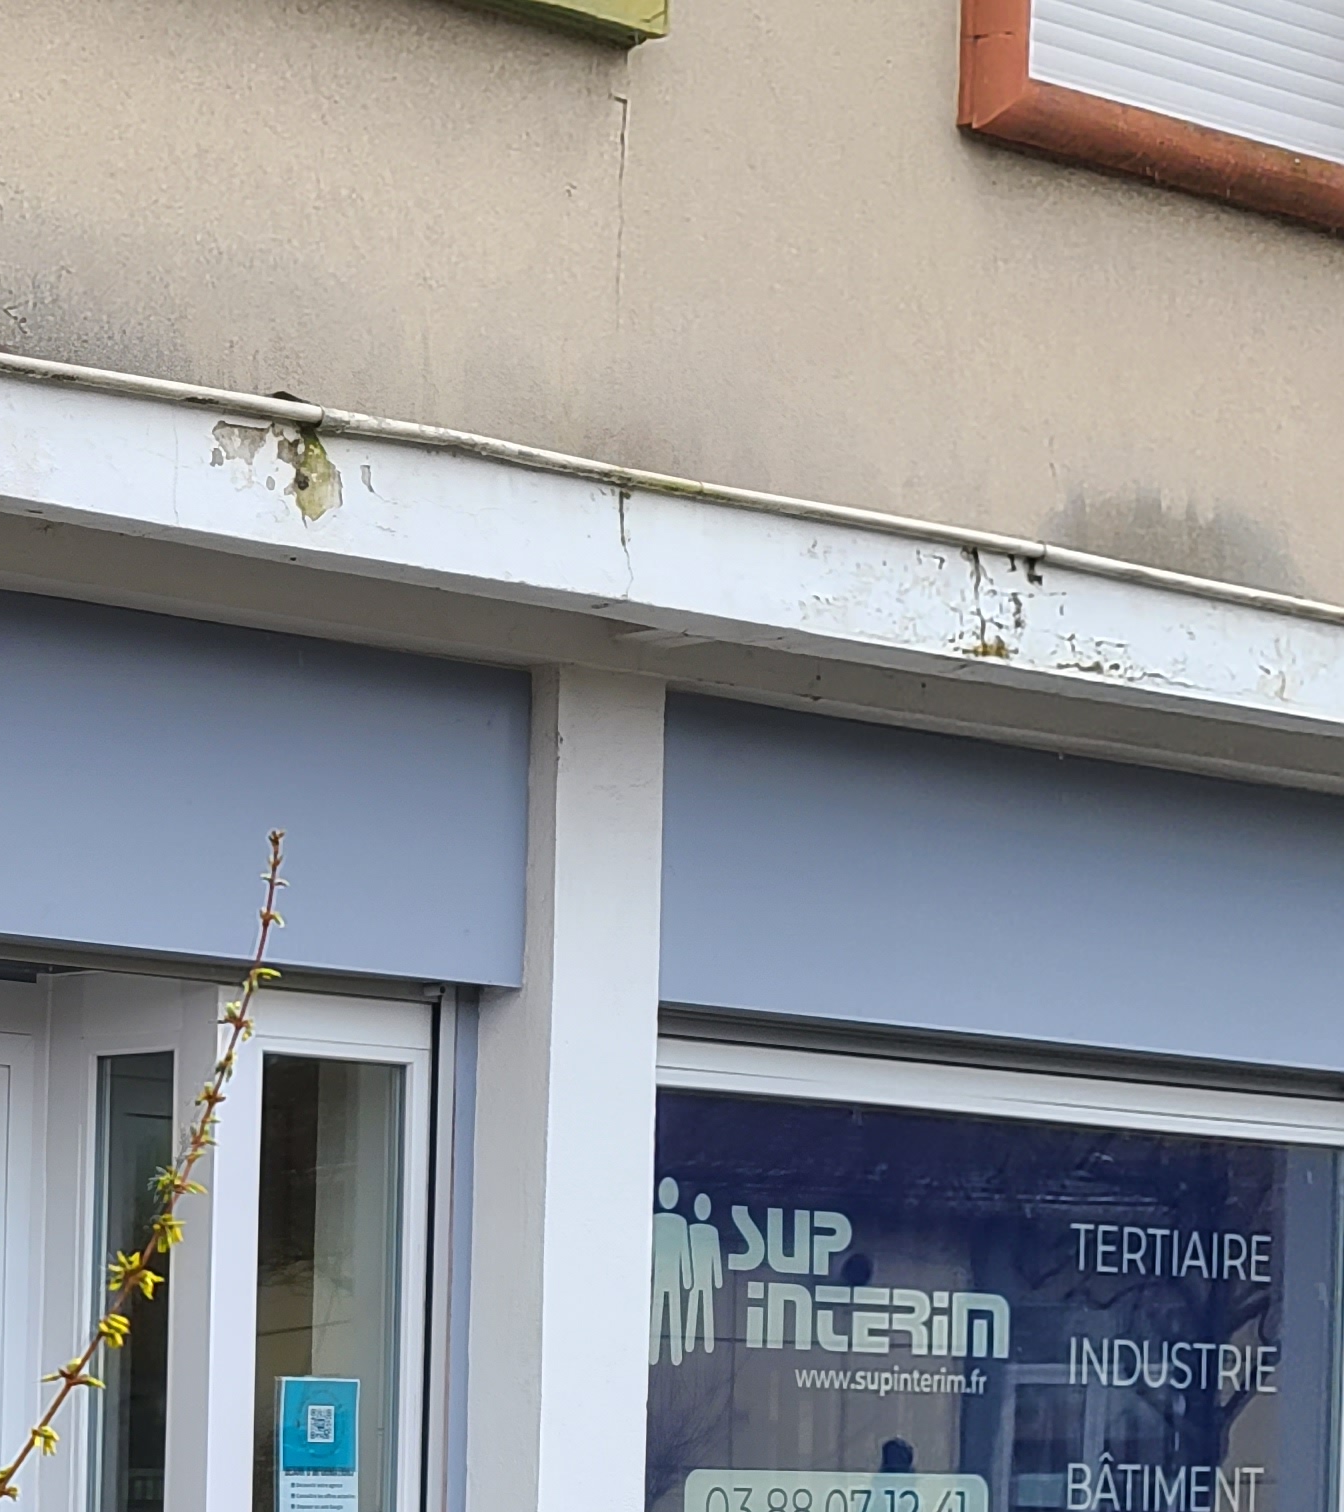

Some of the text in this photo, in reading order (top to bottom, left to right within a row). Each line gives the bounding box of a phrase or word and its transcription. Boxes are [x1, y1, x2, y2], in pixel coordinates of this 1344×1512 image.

[727, 1205, 853, 1276] SUP
[1069, 1222, 1273, 1283] TERTIAIRE
[794, 1364, 988, 1397] www.supinterim.fr
[1068, 1336, 1279, 1393] INDUSTRIE
